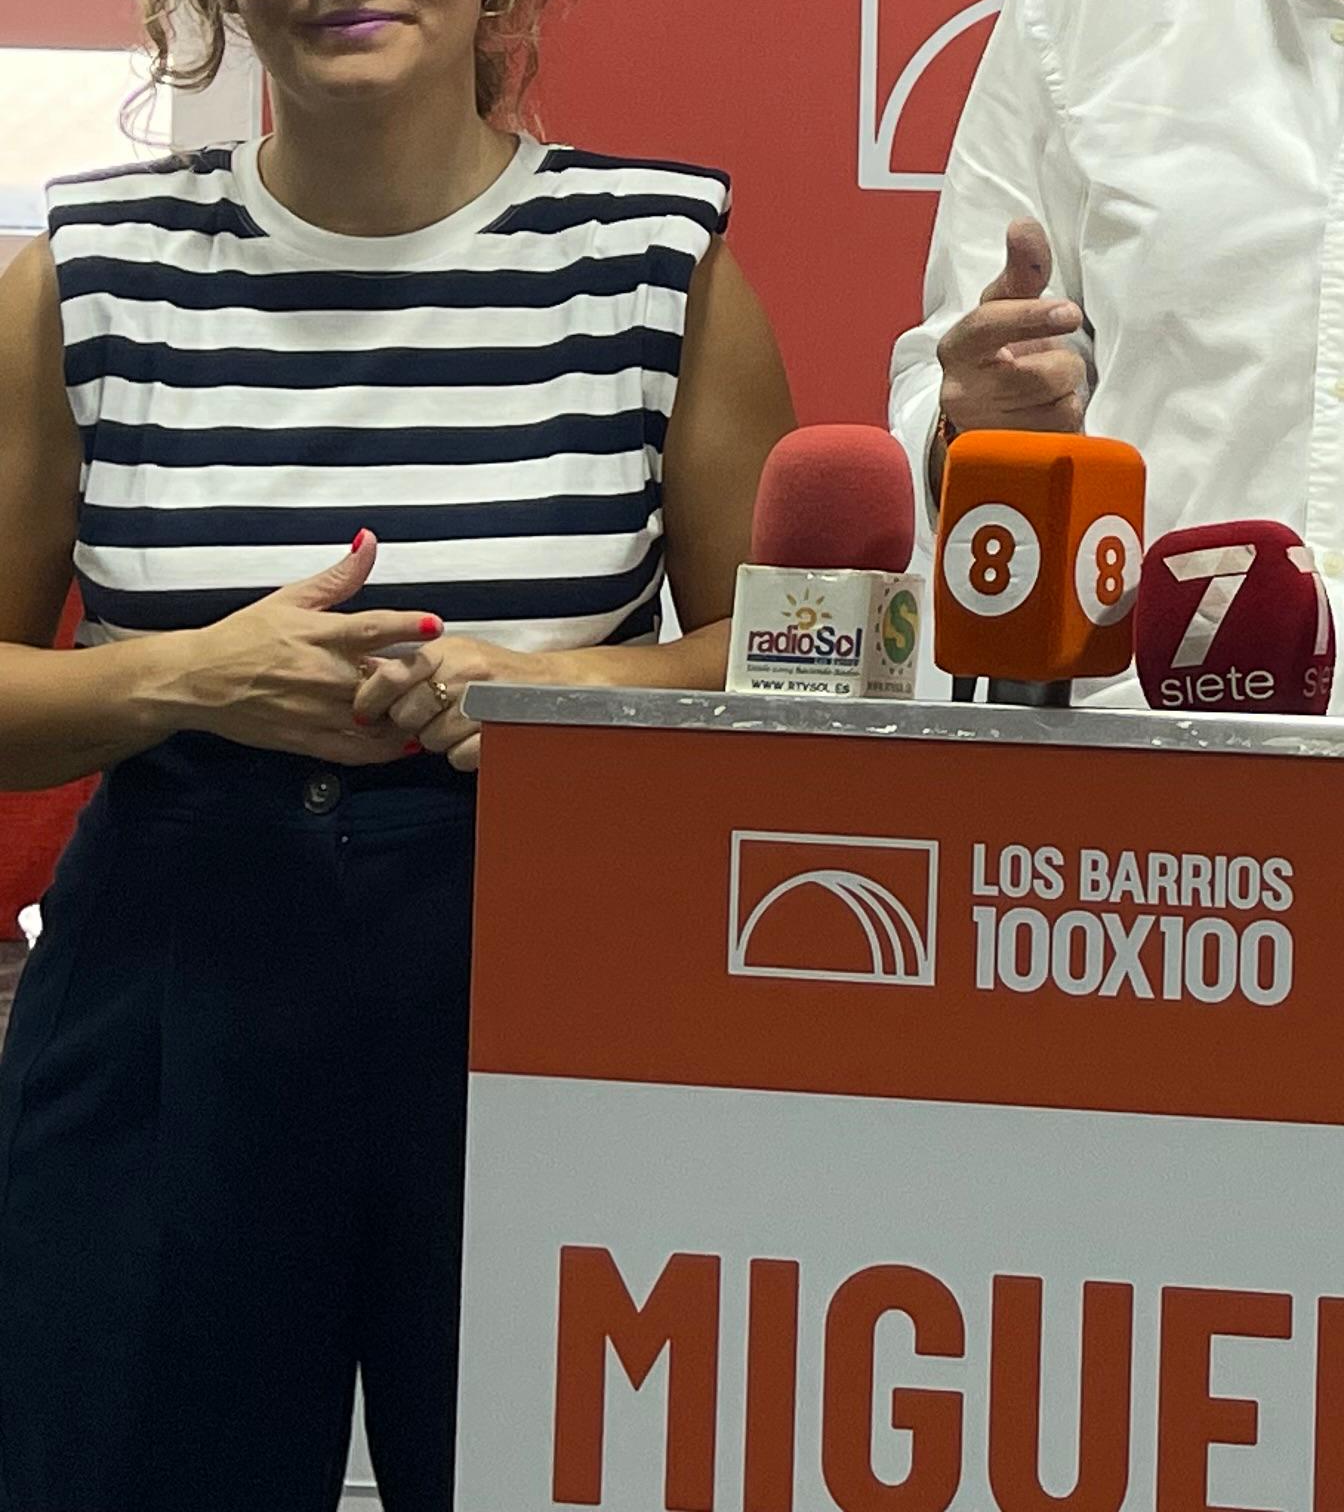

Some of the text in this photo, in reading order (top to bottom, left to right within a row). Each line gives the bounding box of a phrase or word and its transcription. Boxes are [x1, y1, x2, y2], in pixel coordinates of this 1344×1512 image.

[969, 524, 1016, 596] 8
[1096, 535, 1126, 606] 8
[748, 624, 863, 658] radioSol
[1162, 543, 1257, 669] 7
[972, 843, 1294, 912] LOS BARRIOS
[972, 904, 1294, 1007] 100X100
